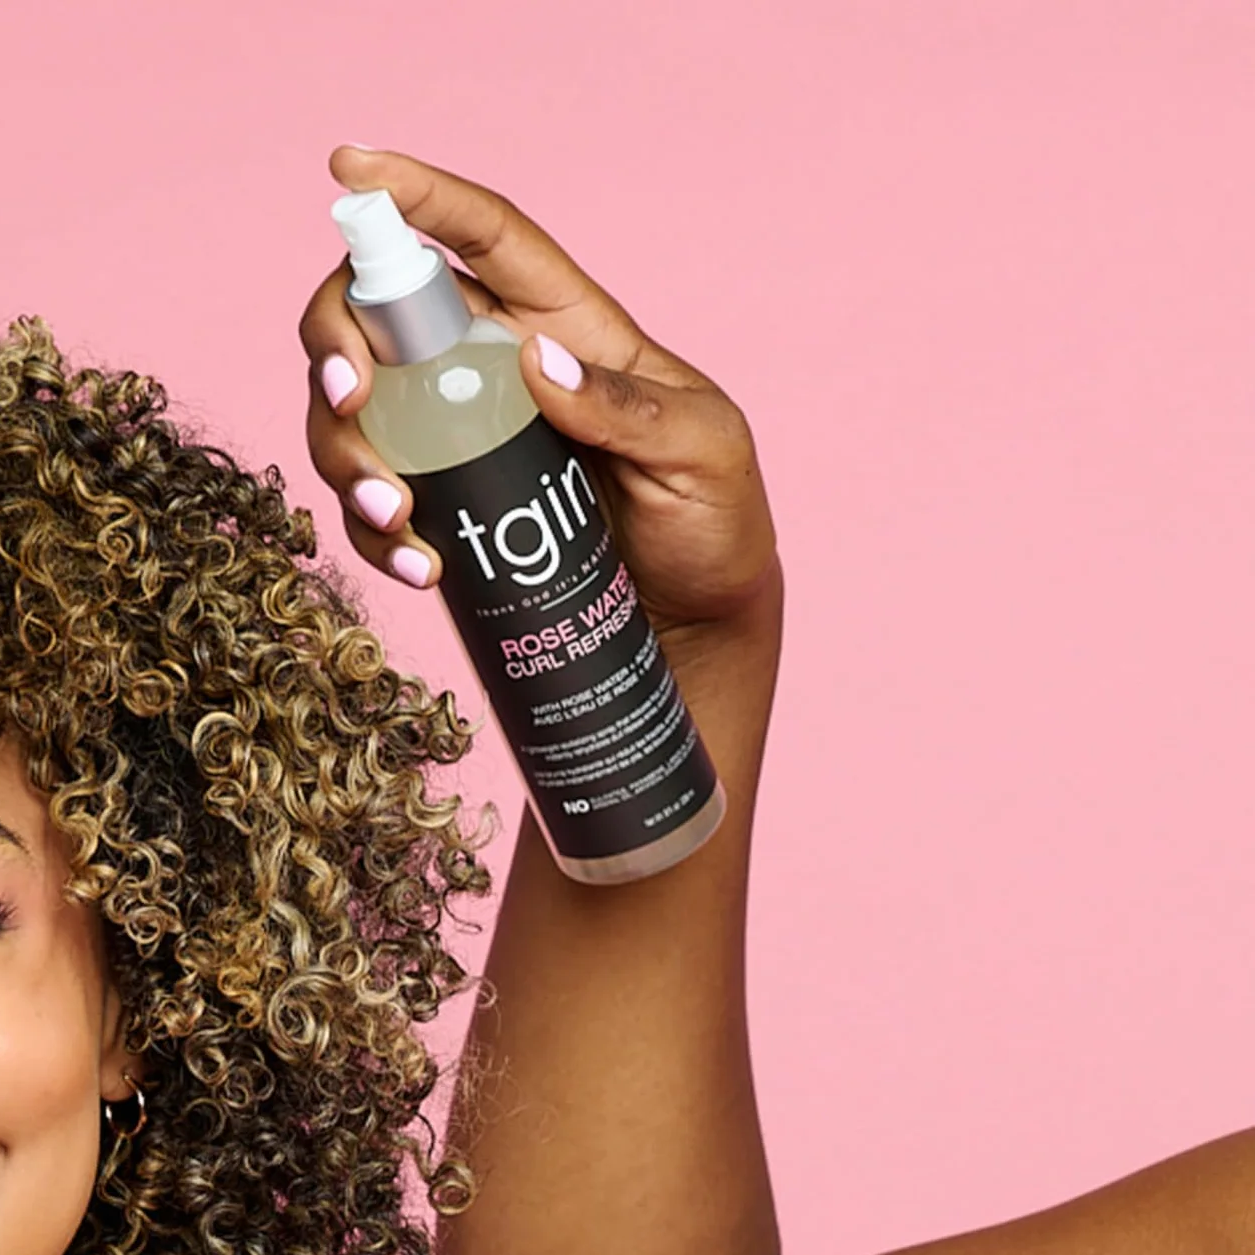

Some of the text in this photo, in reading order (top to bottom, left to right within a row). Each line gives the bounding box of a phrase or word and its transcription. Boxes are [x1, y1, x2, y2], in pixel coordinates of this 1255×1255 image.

[457, 457, 595, 586] tgin
[500, 618, 579, 660] ROSE
[506, 652, 566, 679] CURL
[533, 712, 563, 726] AVEC
[595, 691, 613, 707] DE
[613, 672, 639, 696] ROSE
[561, 688, 594, 708] ROSE
[593, 667, 629, 695] WATER
[562, 799, 590, 815] NO
